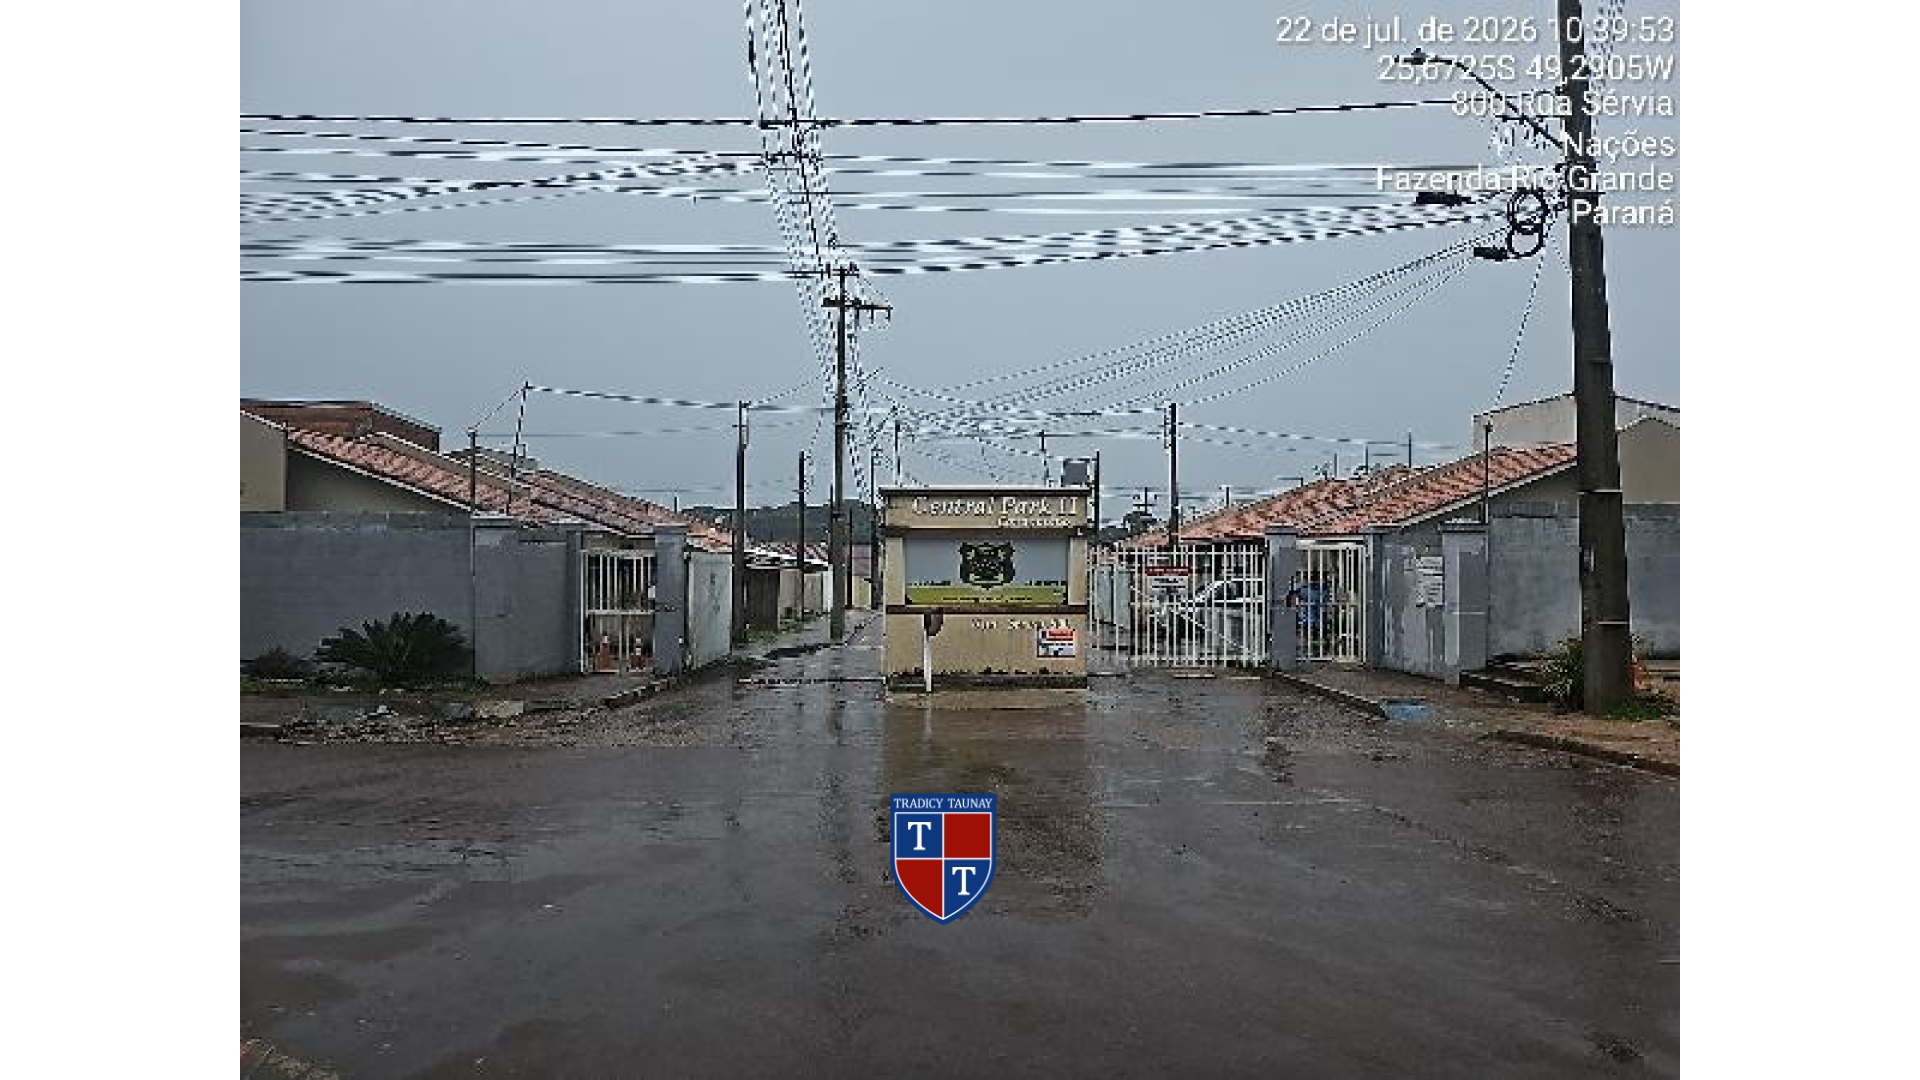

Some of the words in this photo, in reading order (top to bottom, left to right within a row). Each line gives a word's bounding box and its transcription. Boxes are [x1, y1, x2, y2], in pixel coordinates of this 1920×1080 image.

[912, 496, 995, 515] Central
[1000, 496, 1051, 515] Park
[1057, 496, 1079, 515] II
